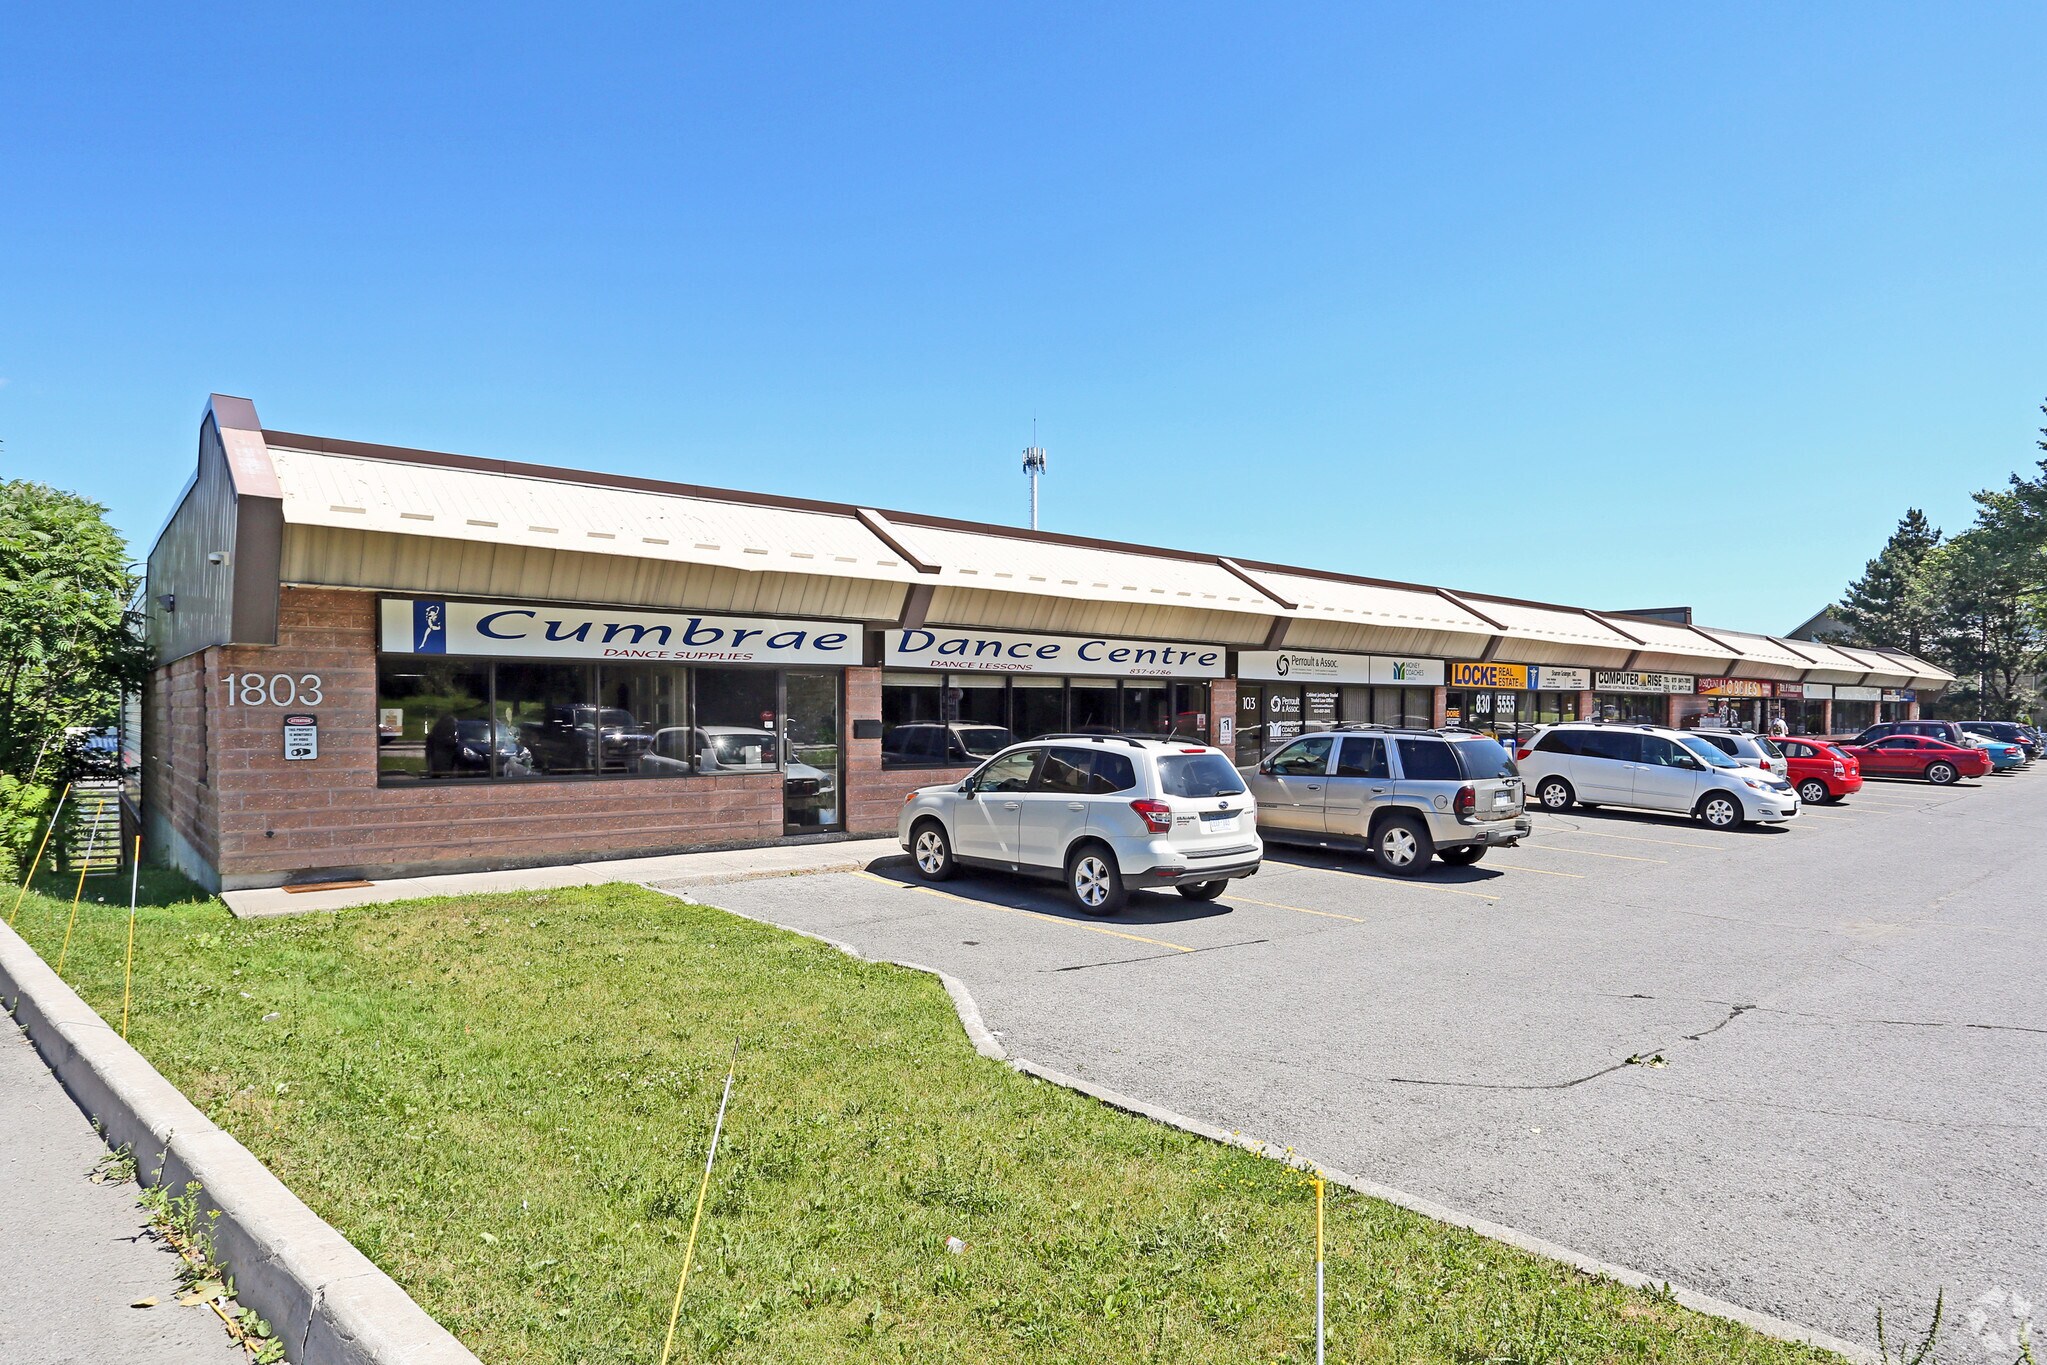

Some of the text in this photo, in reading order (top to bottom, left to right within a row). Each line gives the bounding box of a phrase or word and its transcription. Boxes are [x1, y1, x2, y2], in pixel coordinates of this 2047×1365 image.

[475, 610, 848, 651] Cumbrae
[603, 648, 754, 661] DANCE SUPPLIES
[897, 629, 1218, 667] Dance Centre
[930, 660, 1033, 671] DANCE LESSONS
[1129, 668, 1172, 676] 837-6786
[1498, 667, 1514, 677] REAL
[1454, 664, 1497, 686] LOCKE
[1498, 677, 1519, 687] ESTATE
[1598, 672, 1662, 686] COMPUTER RISE
[221, 673, 323, 707] 1803
[1698, 678, 1719, 688] DISCOUNT
[1720, 679, 1758, 695] HOBBIES
[1242, 697, 1256, 710] 103
[1476, 694, 1515, 713] 830 5555
